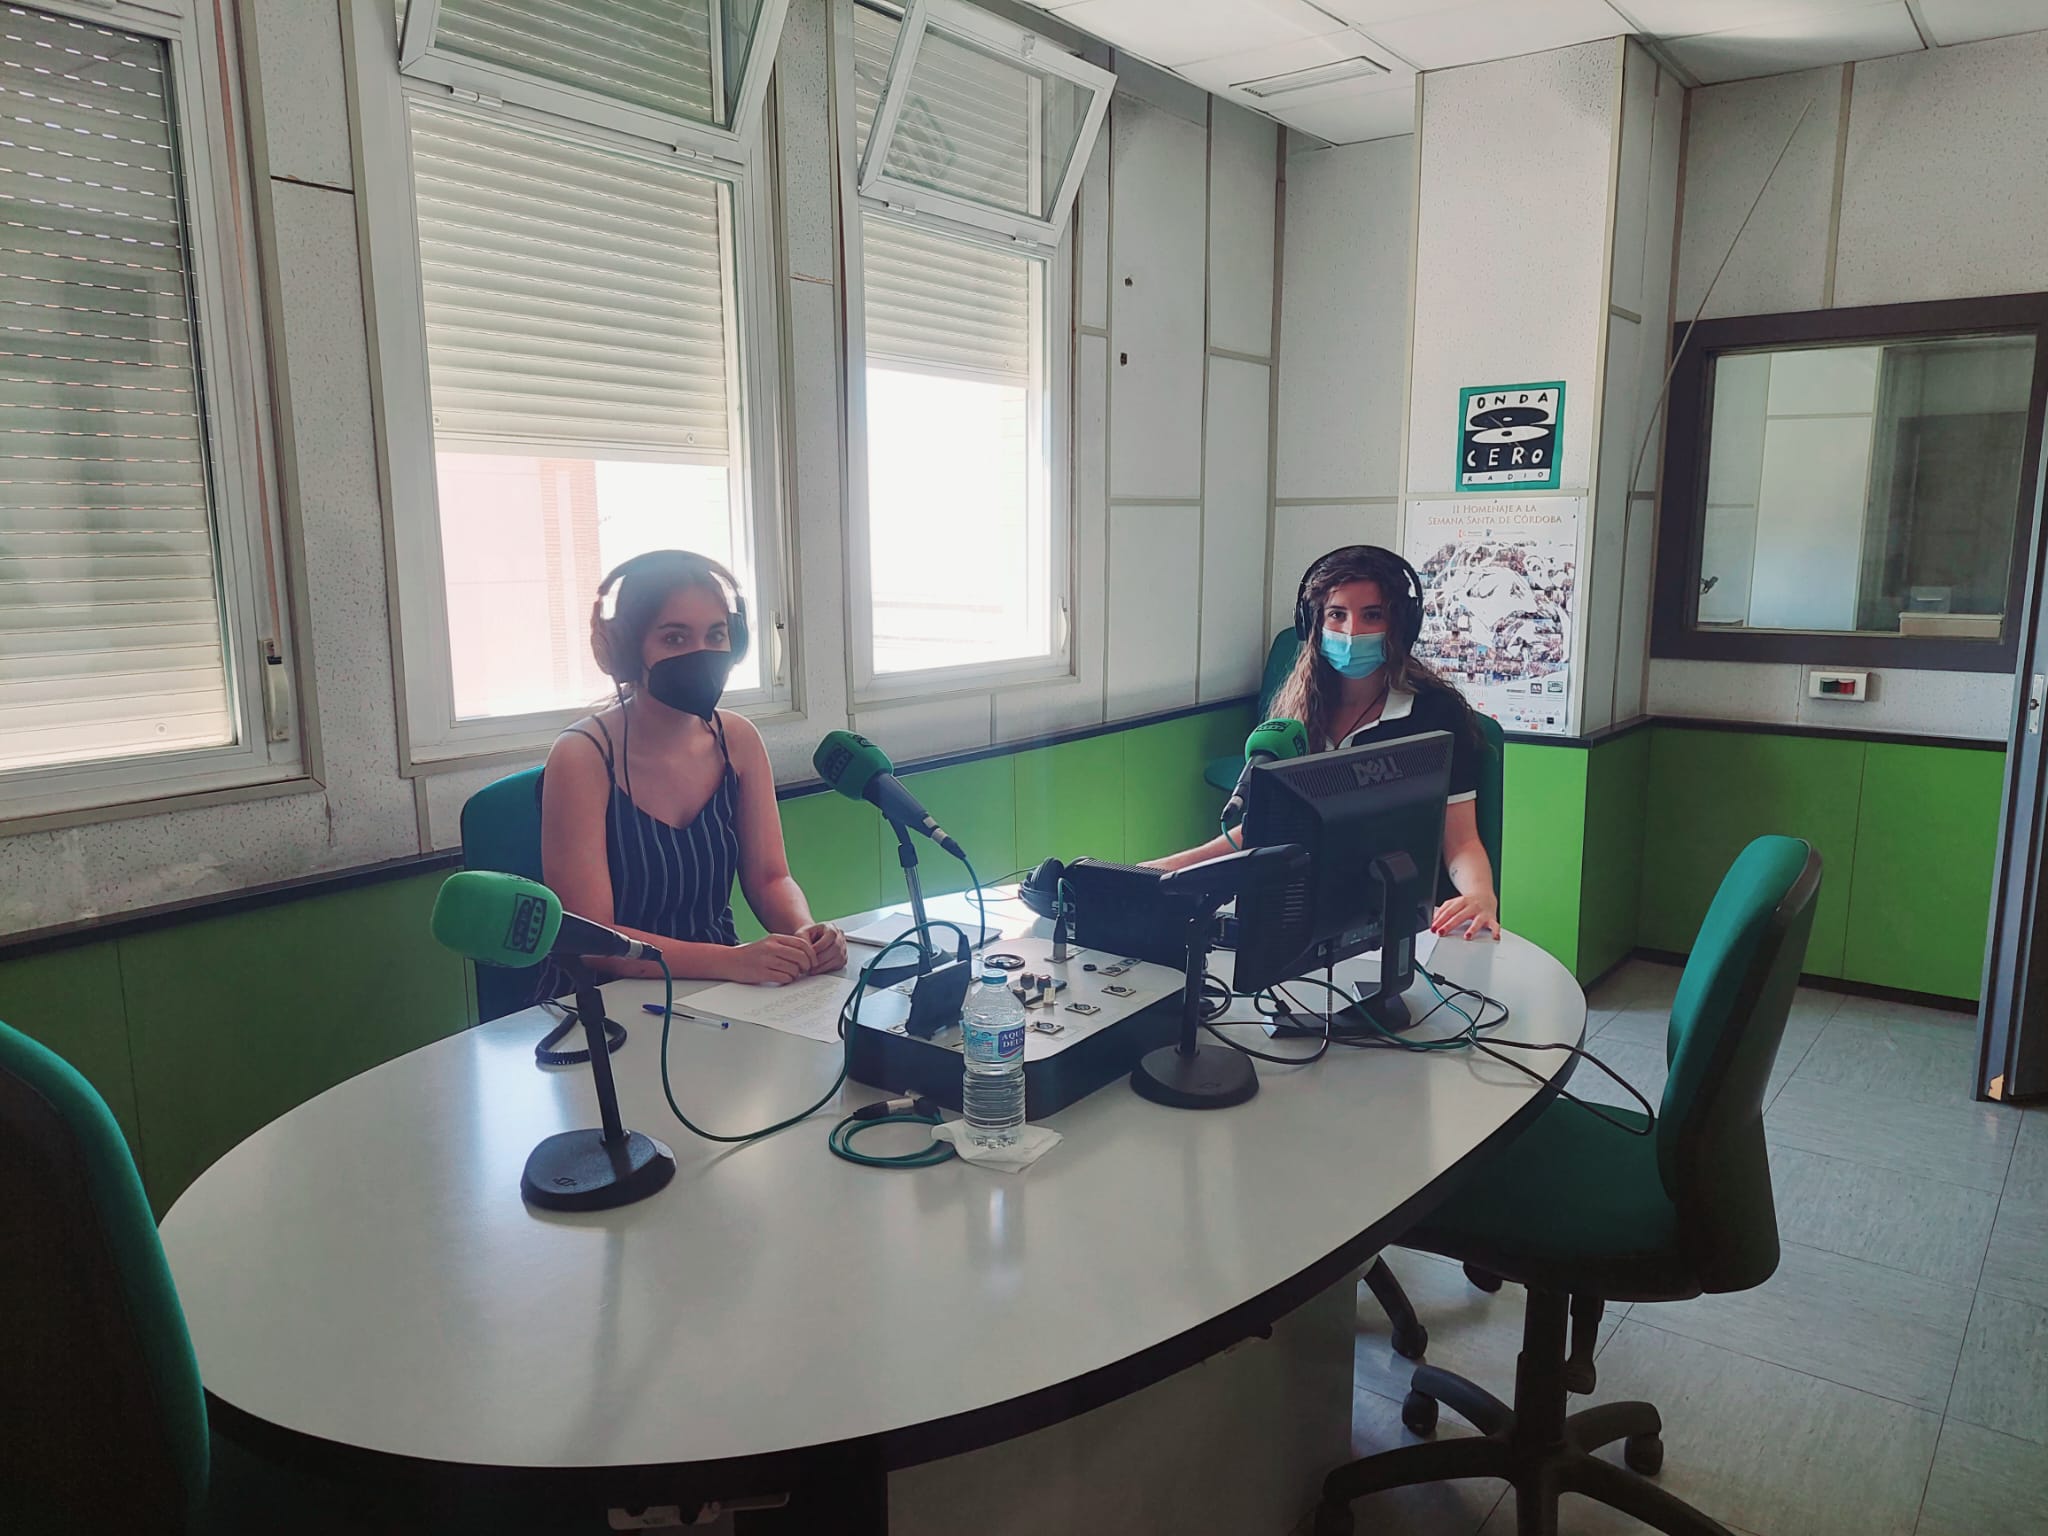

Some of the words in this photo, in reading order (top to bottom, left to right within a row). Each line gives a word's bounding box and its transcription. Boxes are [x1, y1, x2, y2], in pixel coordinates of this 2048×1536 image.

[1477, 392, 1548, 409] ONDA
[1466, 447, 1543, 467] CERO
[1467, 472, 1543, 482] RADIO
[1464, 505, 1513, 514] HOMENAJE
[1514, 504, 1522, 513] A
[1525, 504, 1537, 513] LA
[1428, 517, 1464, 525] SEMANA
[1467, 516, 1495, 525] SANTA
[1499, 516, 1510, 524] DE
